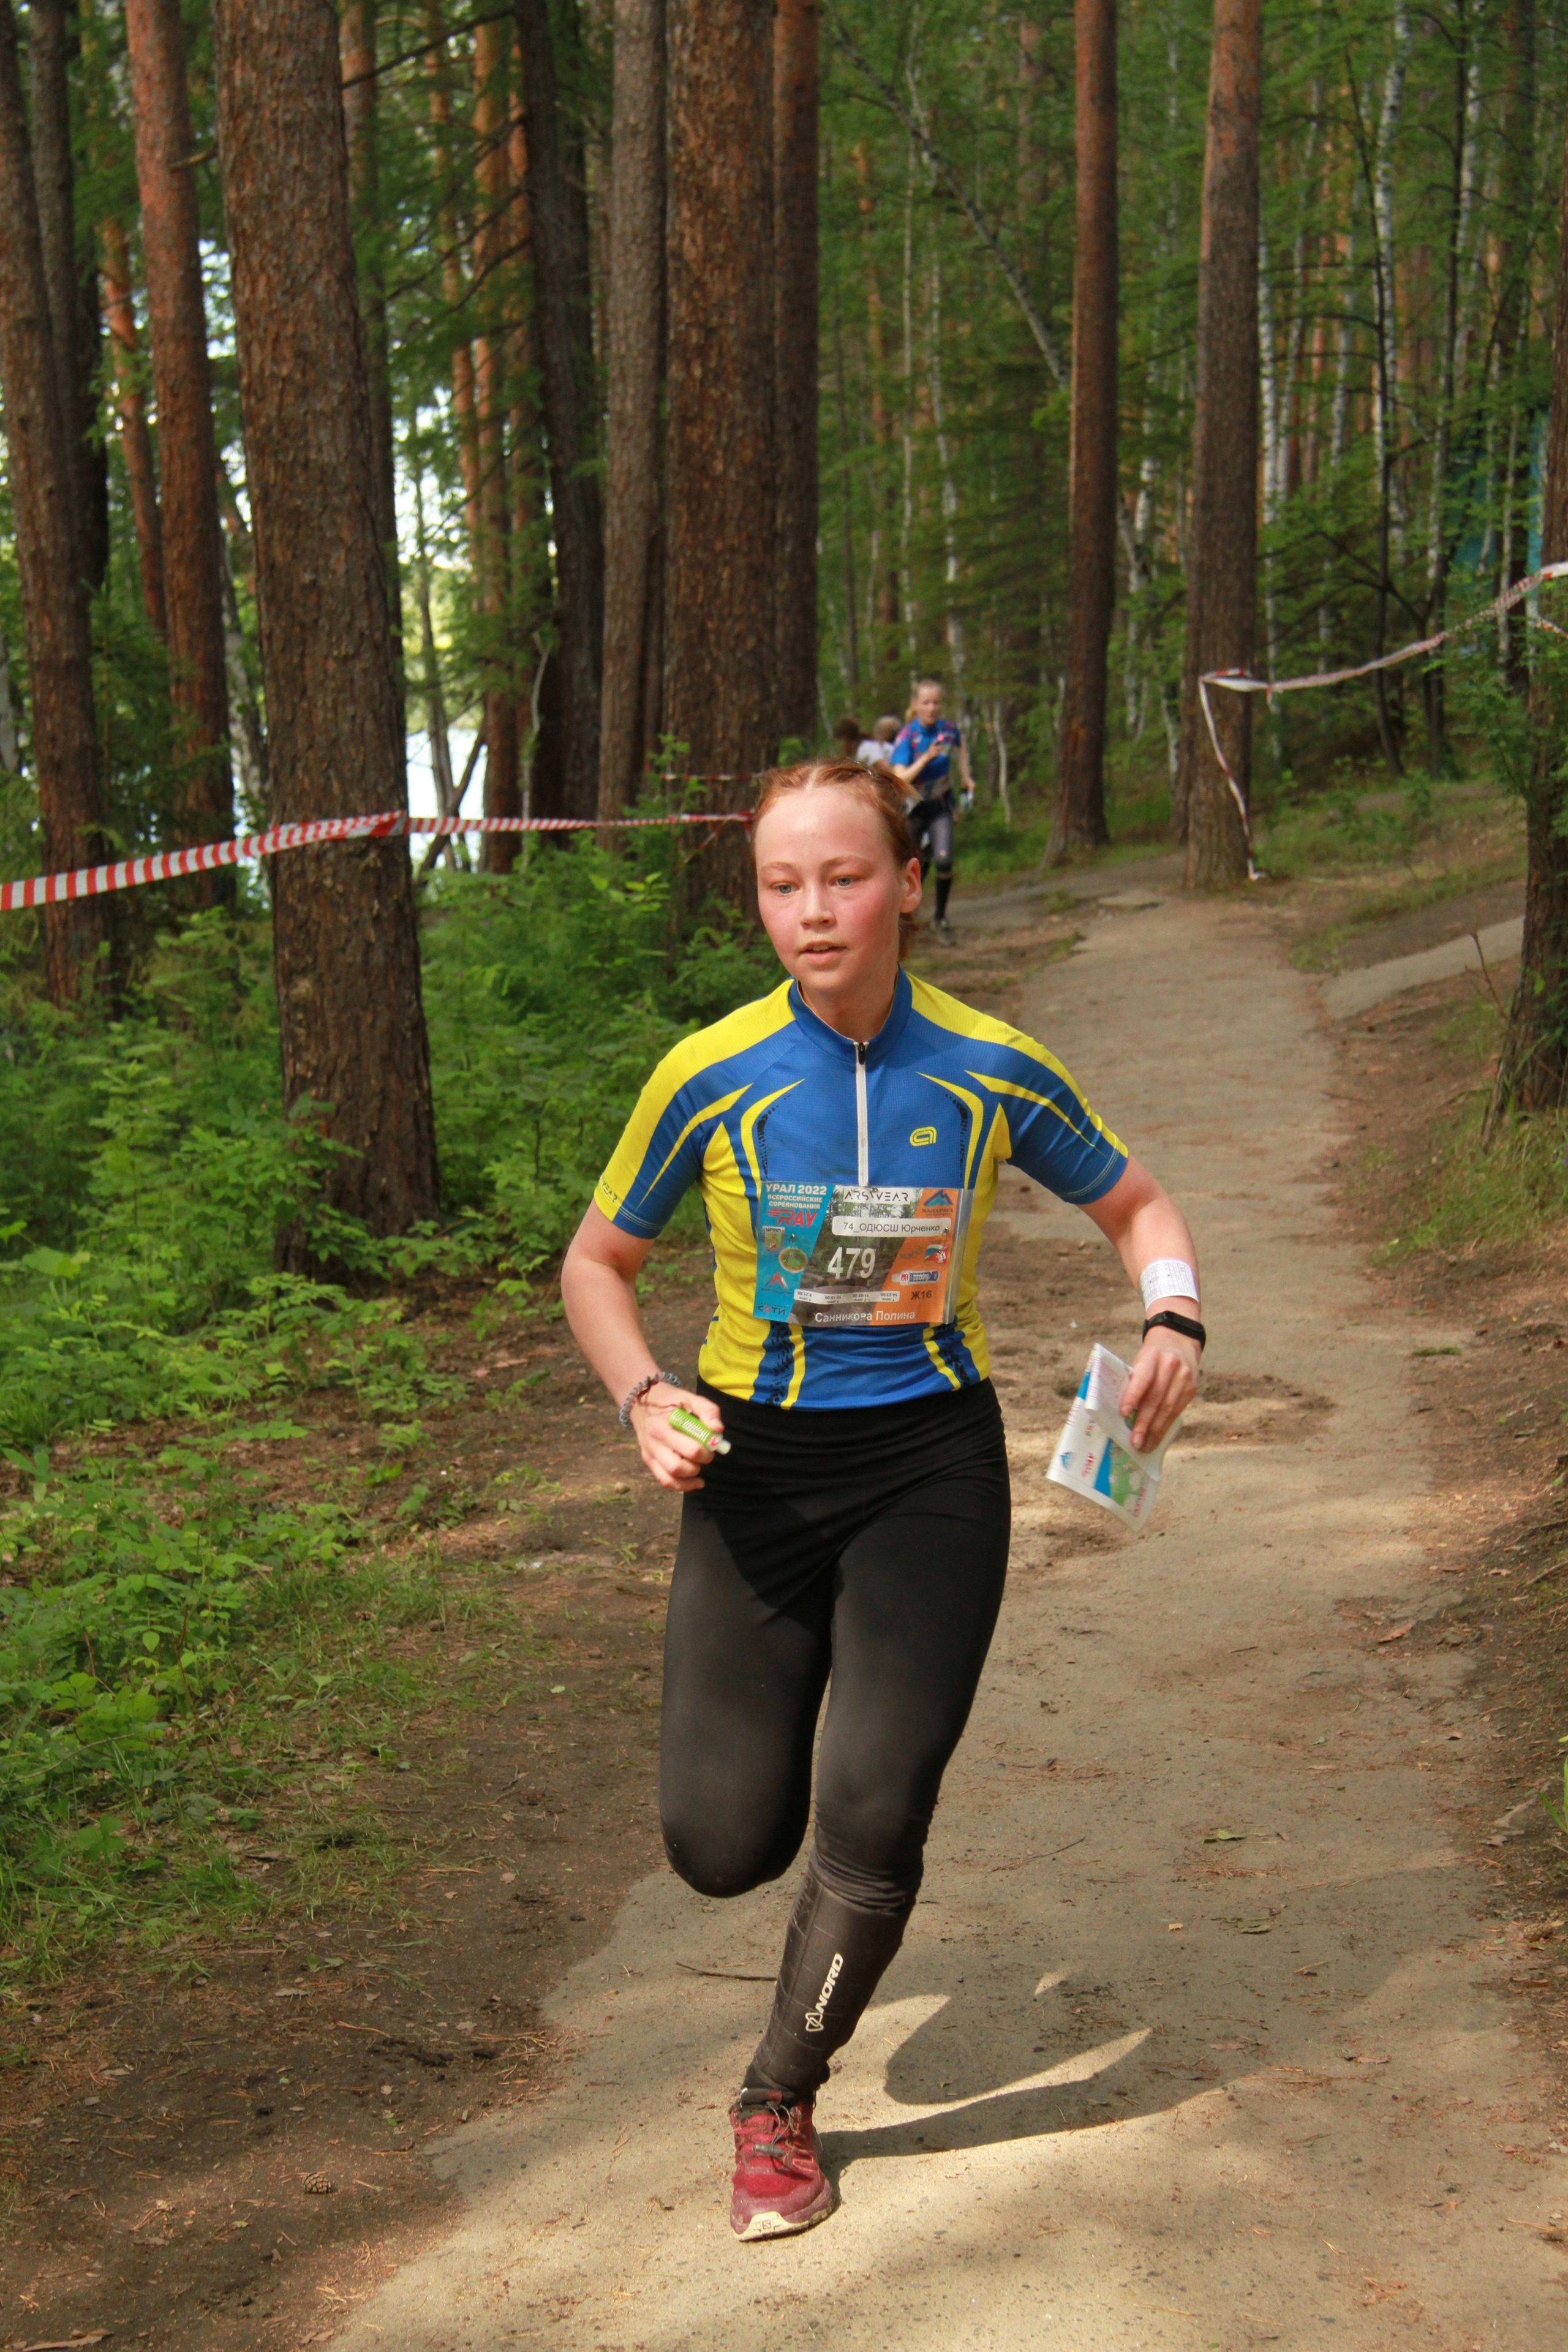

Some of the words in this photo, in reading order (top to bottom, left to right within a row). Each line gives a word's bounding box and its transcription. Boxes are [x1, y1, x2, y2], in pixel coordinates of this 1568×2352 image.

[766, 1184, 795, 1193] УРАЛ
[797, 1185, 827, 1195] 2022
[766, 1208, 818, 1227] RAY
[843, 1222, 899, 1233] 74_ОДЮСШ
[902, 1225, 940, 1234] Юрченко
[827, 1247, 876, 1279] 479
[911, 1291, 932, 1300] Ж16
[815, 1312, 872, 1322] Санникова
[876, 1311, 915, 1321] Полина
[815, 1953, 843, 2013] NORD
